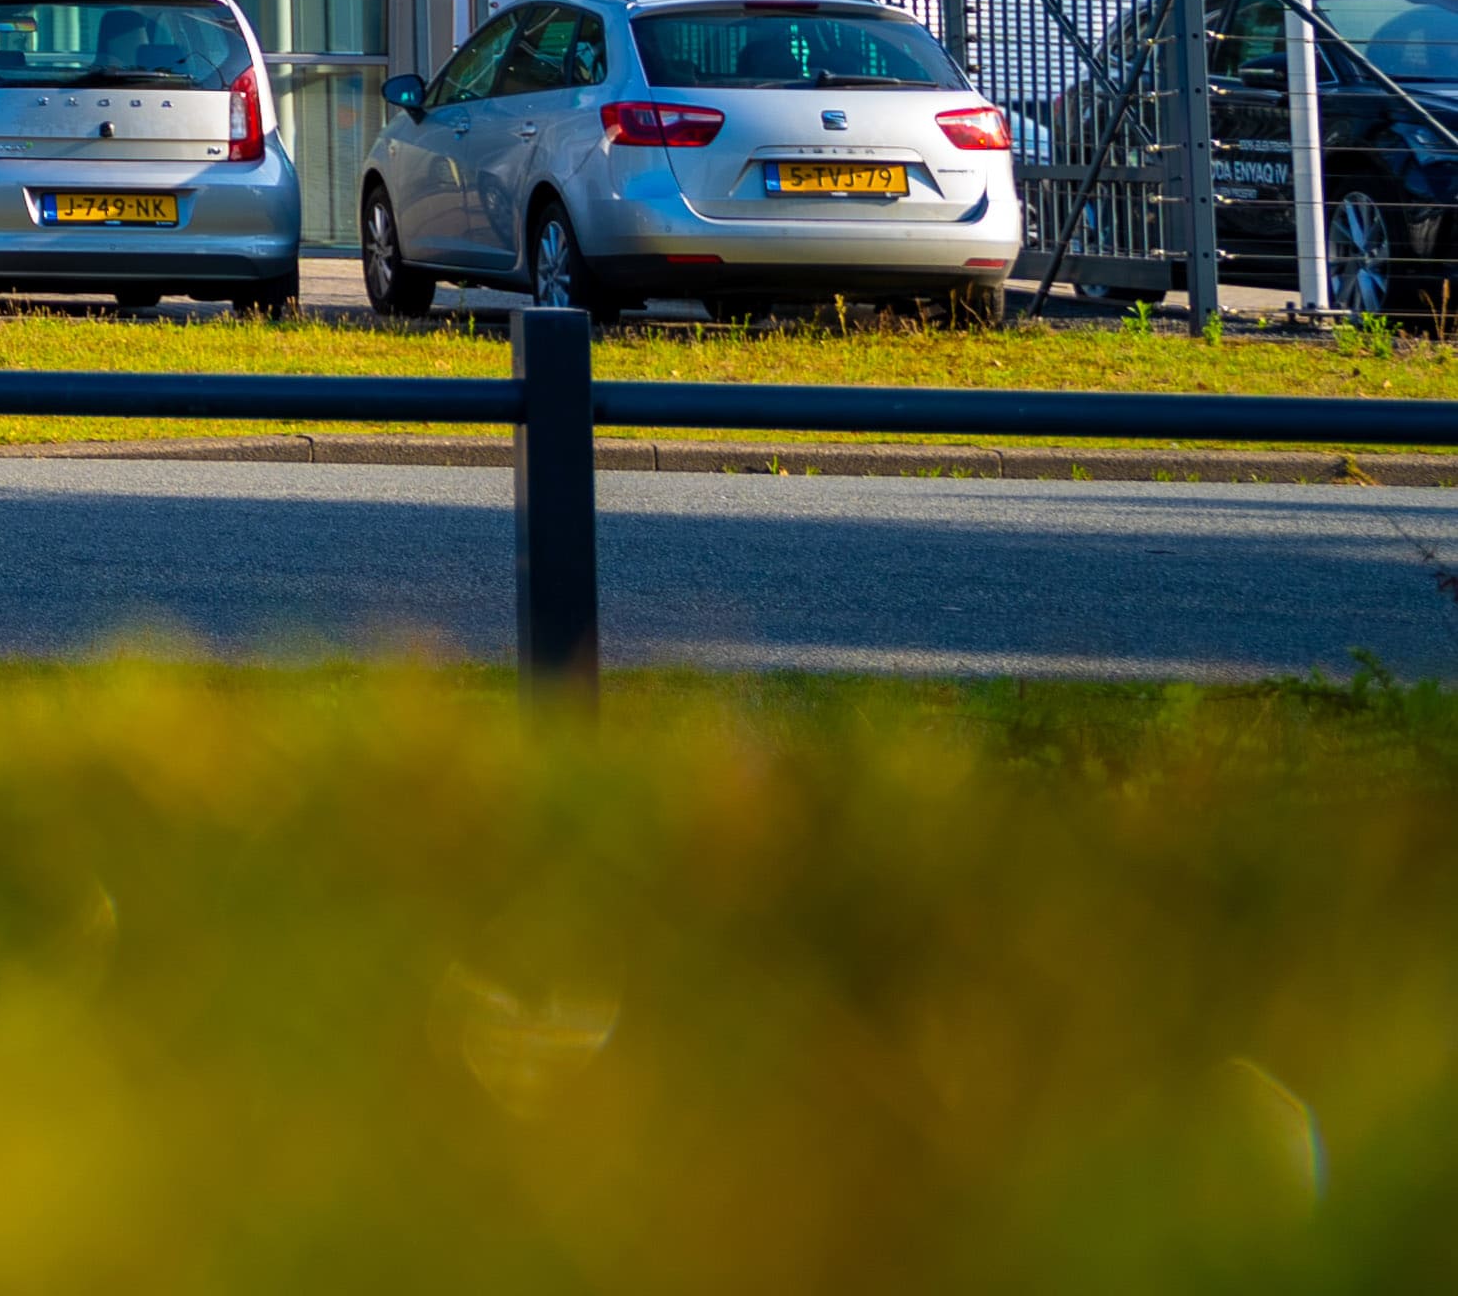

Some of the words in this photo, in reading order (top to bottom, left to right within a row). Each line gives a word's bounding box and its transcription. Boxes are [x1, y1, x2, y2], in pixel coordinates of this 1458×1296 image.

[791, 167, 893, 187] 5-TVJ-79
[1234, 161, 1273, 184] ENYAQ
[64, 197, 167, 217] J-749-NK
